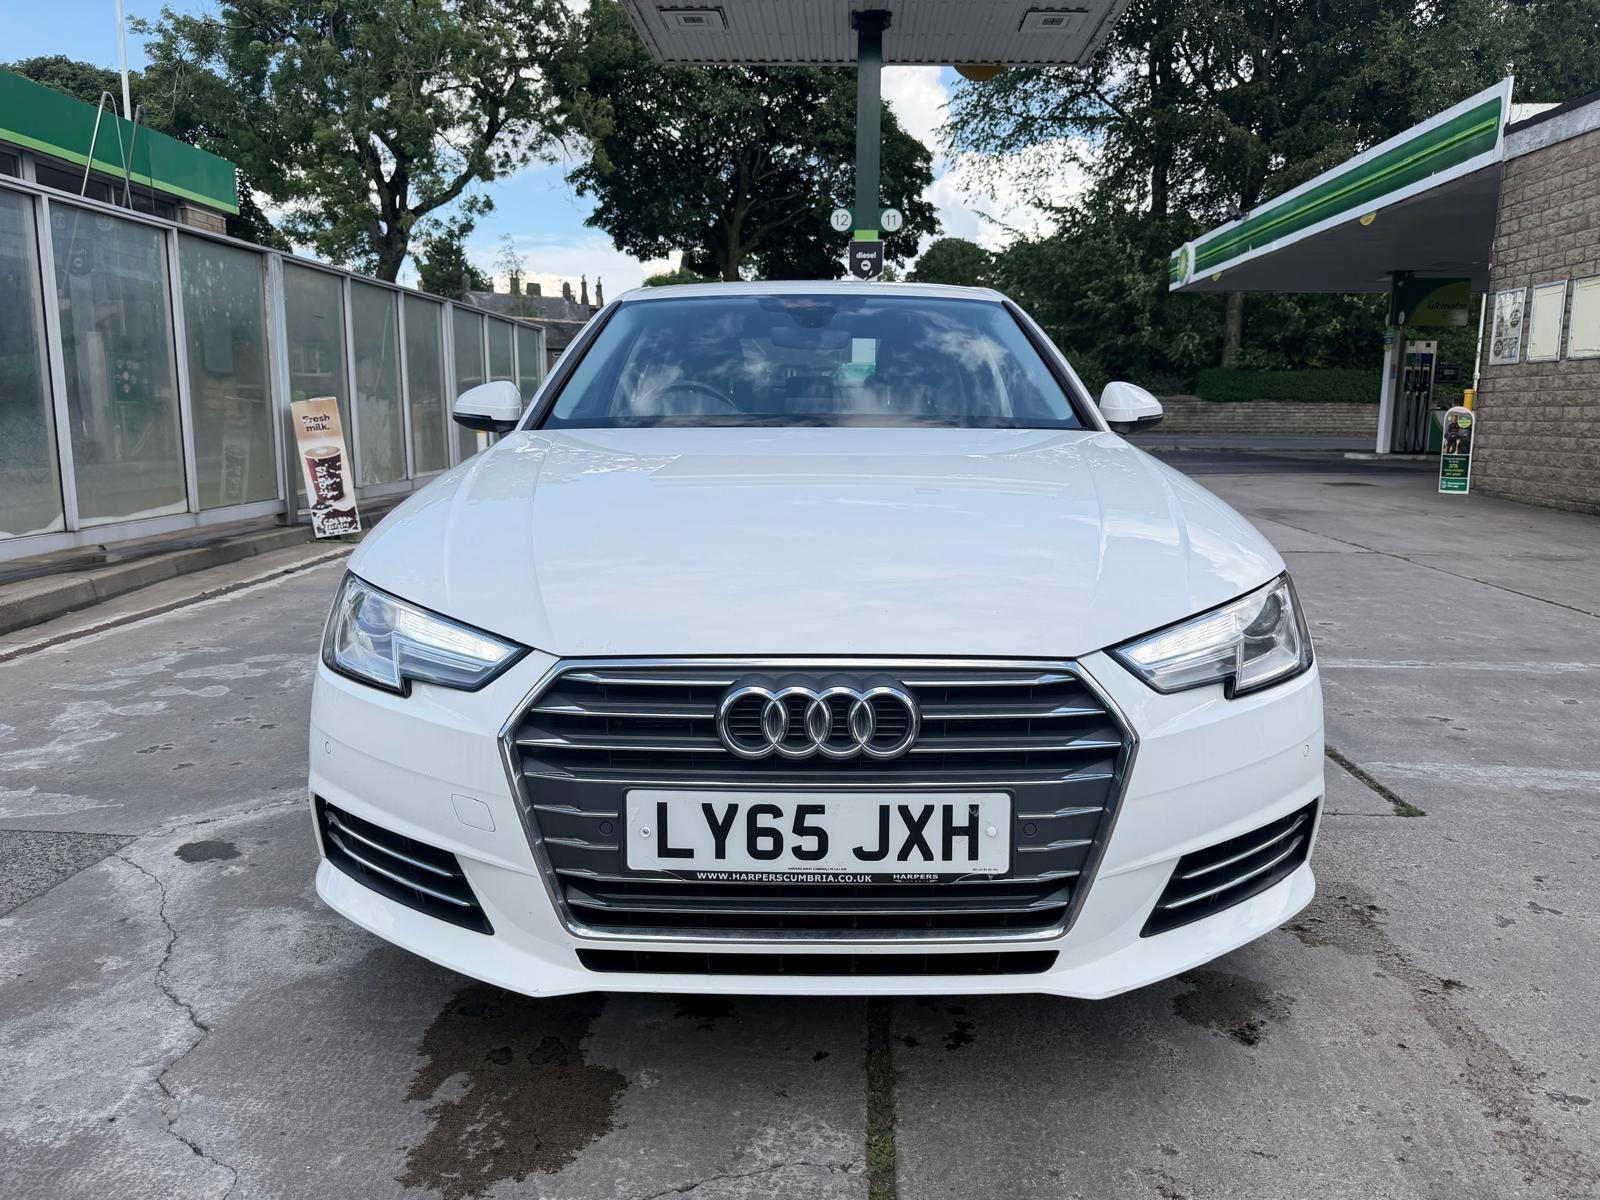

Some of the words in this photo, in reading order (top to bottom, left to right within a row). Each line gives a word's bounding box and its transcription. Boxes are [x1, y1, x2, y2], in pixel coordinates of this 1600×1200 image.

[834, 214, 849, 226] 12
[885, 214, 896, 226] 11
[856, 251, 877, 259] diesel
[302, 413, 330, 424] Fresh
[305, 423, 331, 432] milk.
[656, 801, 829, 861] LY65
[852, 804, 980, 862] JXH
[696, 872, 873, 883] WWW.HARPERSCUMBRIA.CO.UK
[892, 873, 939, 881] HARPERS
